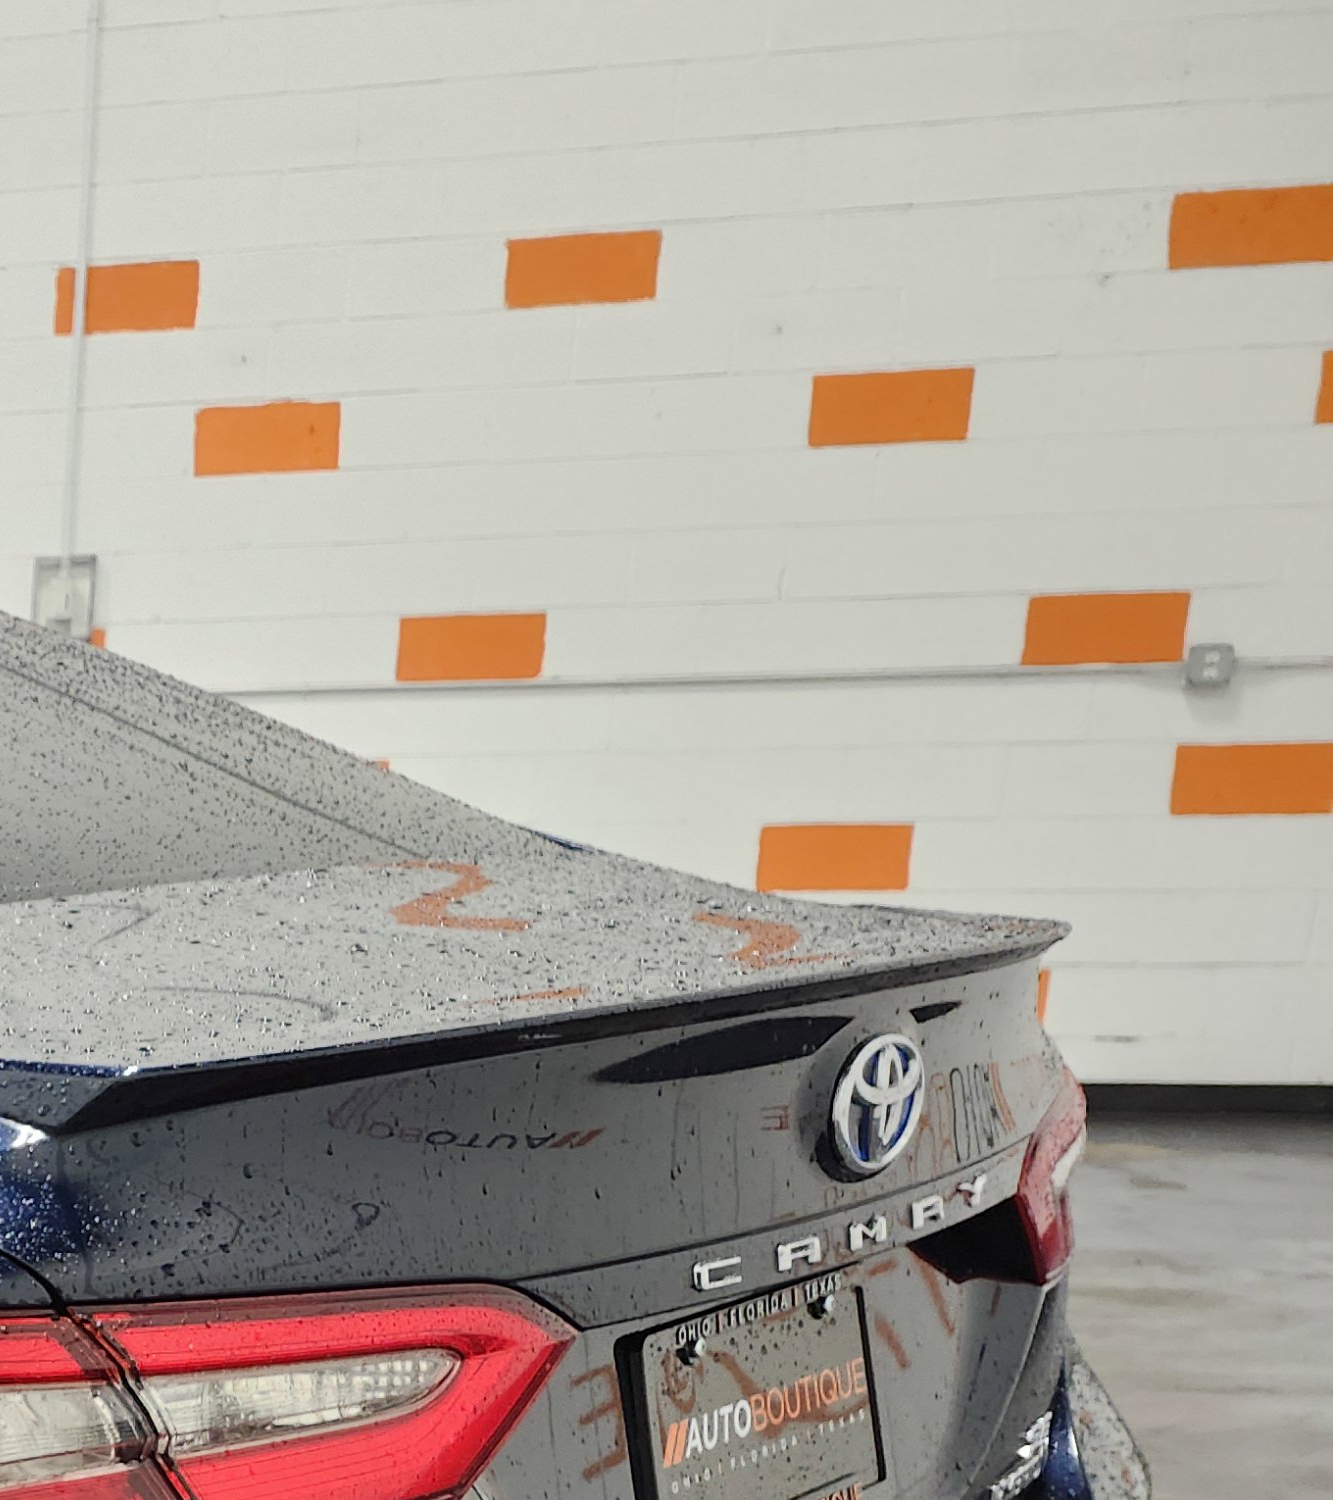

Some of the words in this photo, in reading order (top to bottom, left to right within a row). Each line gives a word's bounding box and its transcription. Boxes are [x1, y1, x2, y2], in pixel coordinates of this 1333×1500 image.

[694, 1174, 989, 1291] CAMRY
[678, 1322, 710, 1345] OHIO
[730, 1294, 787, 1328] FLORIDA
[803, 1274, 842, 1302] TEXAS
[671, 1467, 711, 1494] OHIO
[730, 1434, 798, 1470] FLORIDA
[818, 1408, 866, 1437] TEXAS
[685, 1357, 868, 1459] AUTOBOUTIQUE
